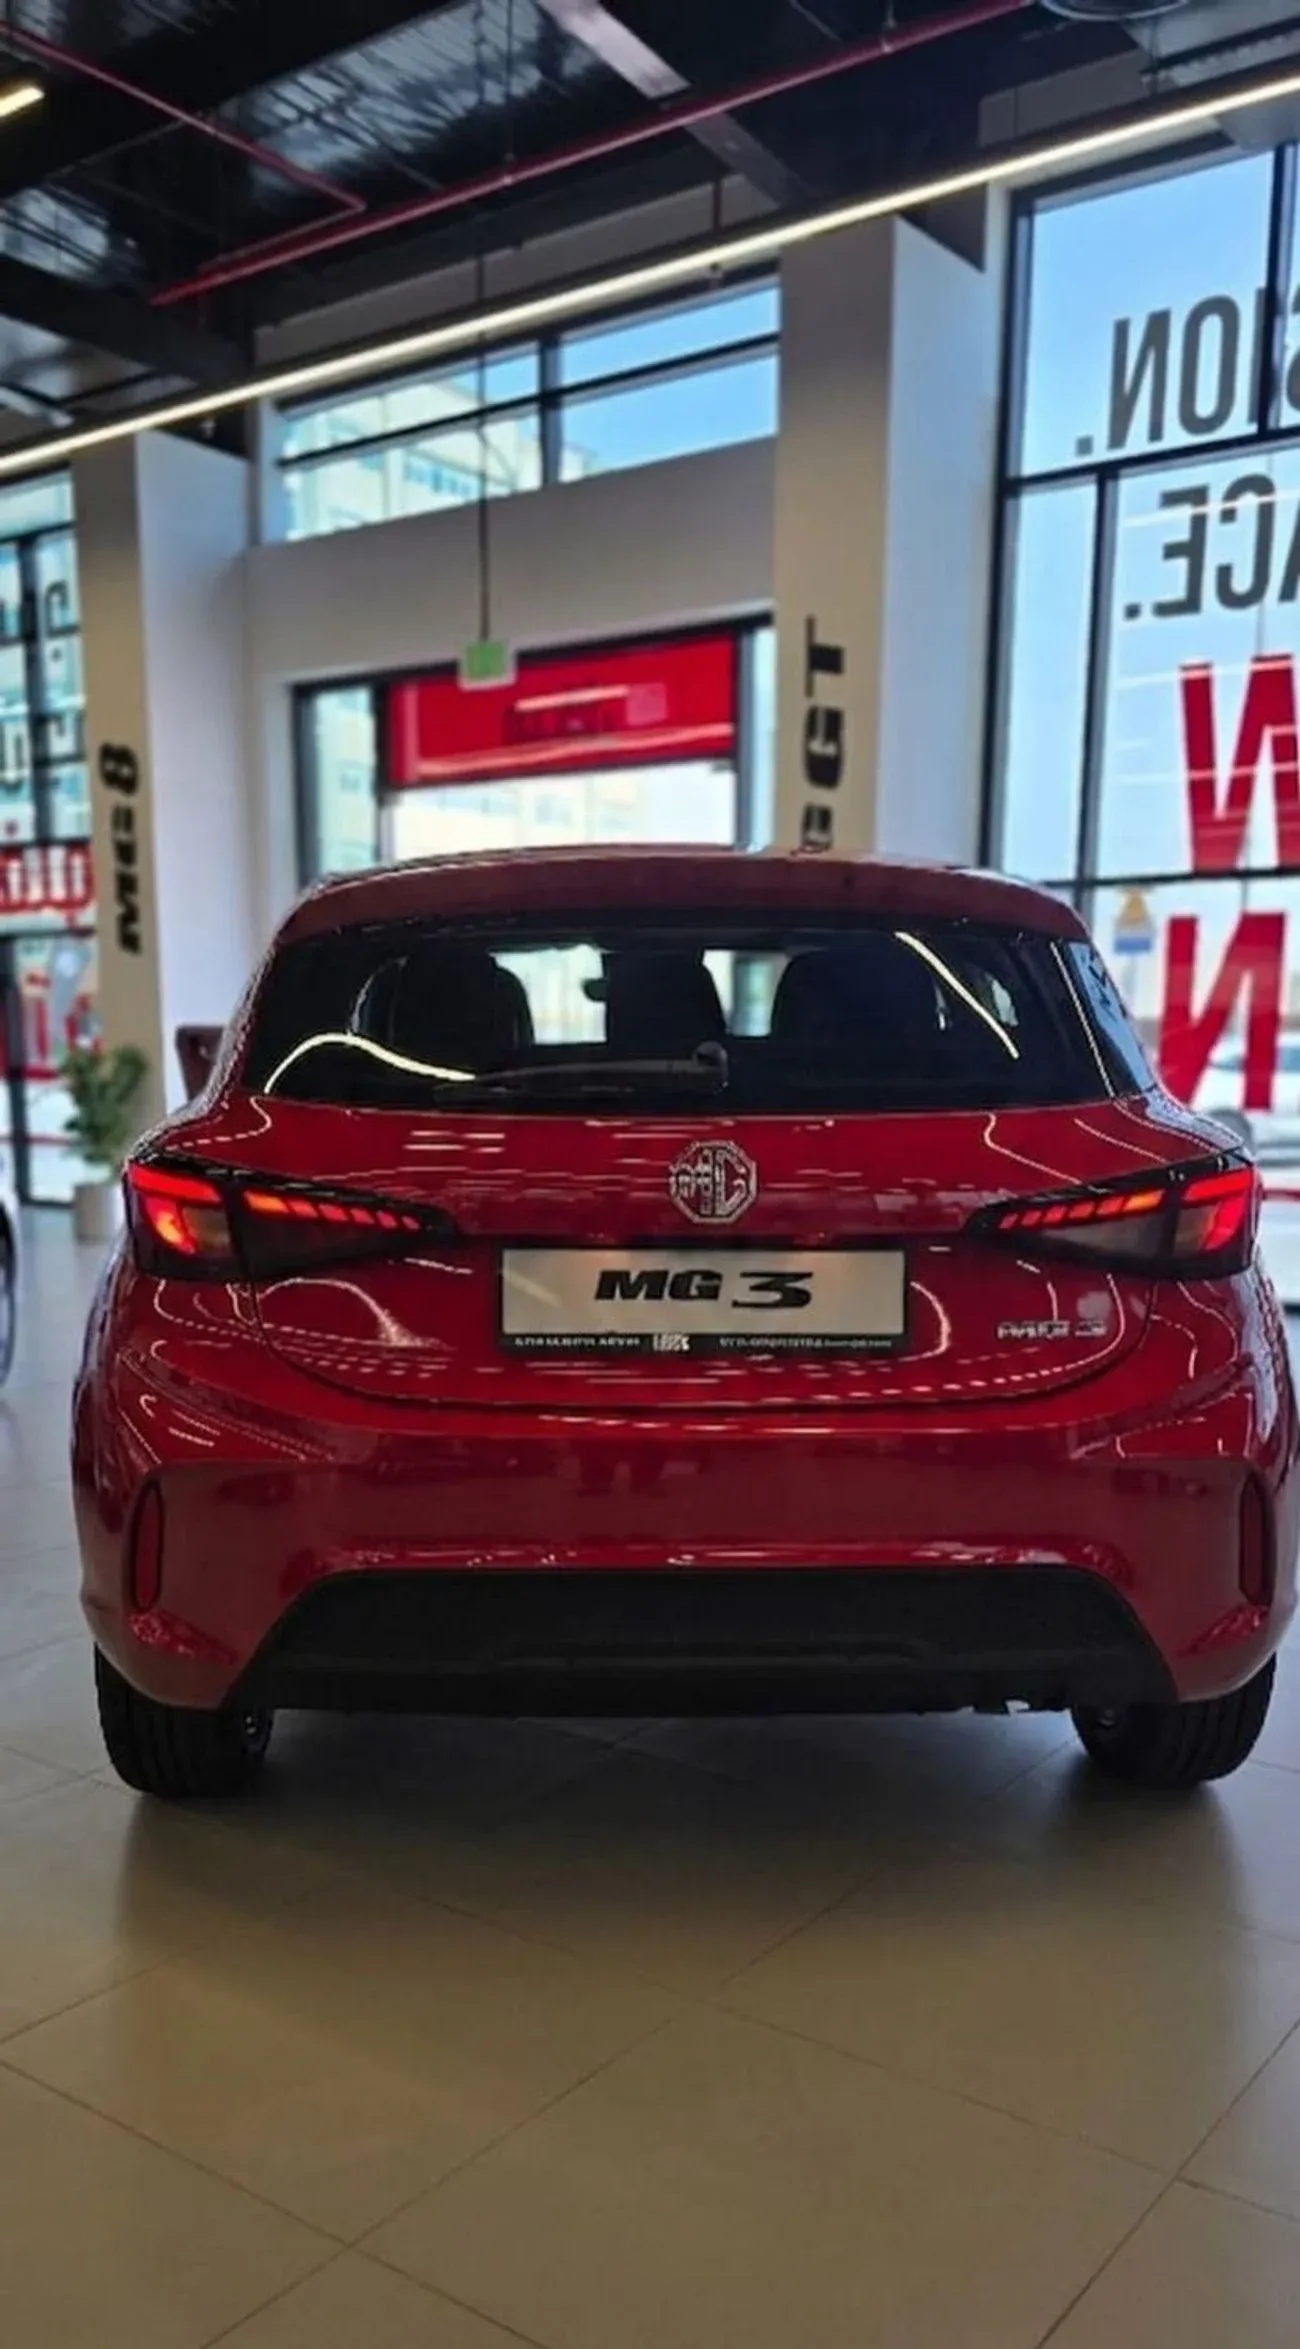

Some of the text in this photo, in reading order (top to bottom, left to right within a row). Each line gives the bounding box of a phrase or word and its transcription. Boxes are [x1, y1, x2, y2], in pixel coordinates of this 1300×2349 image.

[669, 1142, 756, 1222] MG
[594, 1269, 814, 1309] MG 3
